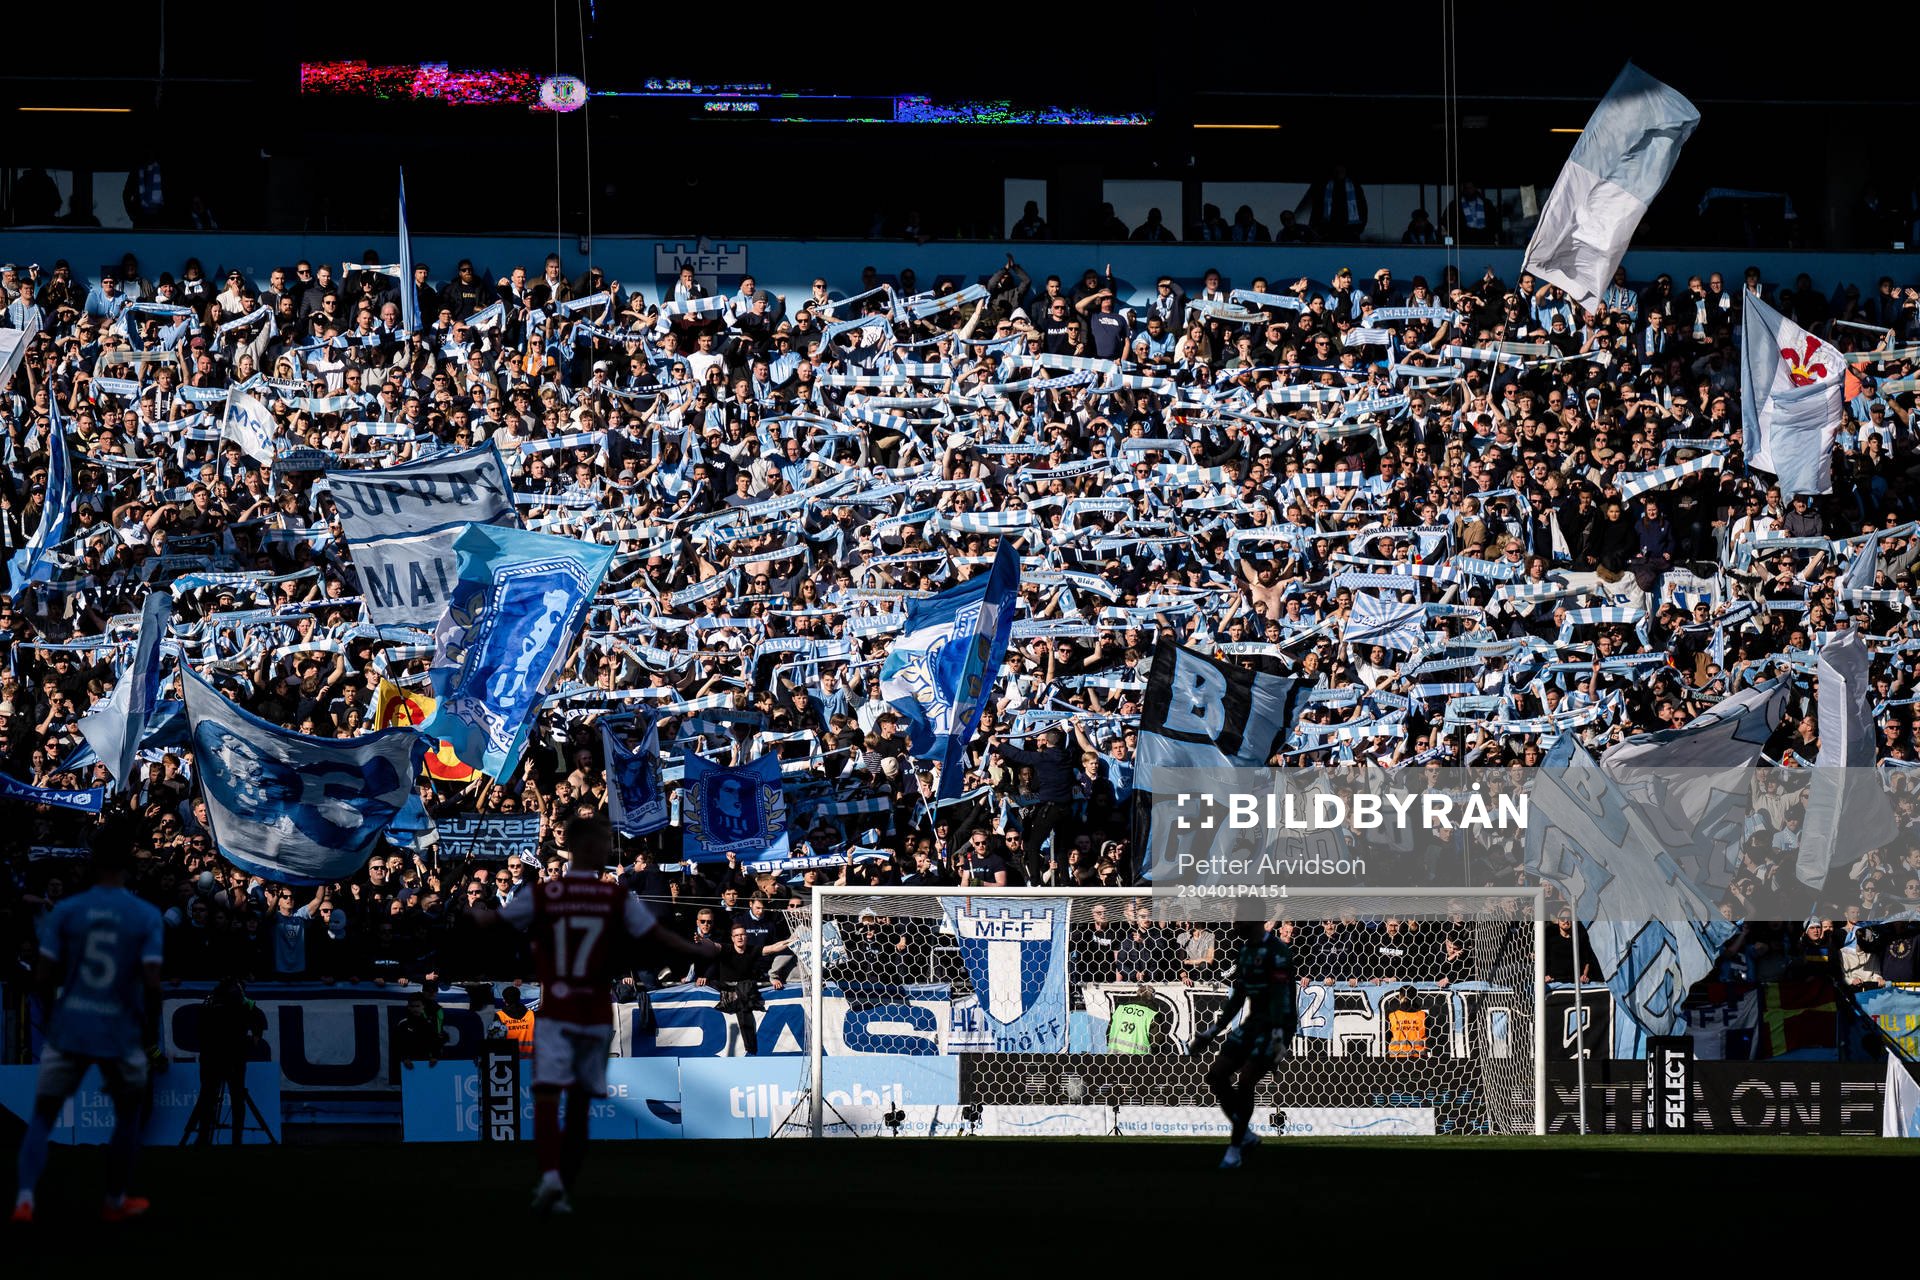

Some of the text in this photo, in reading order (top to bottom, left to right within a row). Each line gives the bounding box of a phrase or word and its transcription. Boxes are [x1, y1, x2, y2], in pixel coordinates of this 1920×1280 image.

[80, 930, 119, 990] 5
[552, 915, 607, 979] 17
[1120, 1021, 1136, 1035] 39
[1123, 1007, 1145, 1017] FOTO
[488, 1052, 515, 1141] SELECT
[1664, 1049, 1686, 1129] SELECT
[1192, 1120, 1214, 1134] pris
